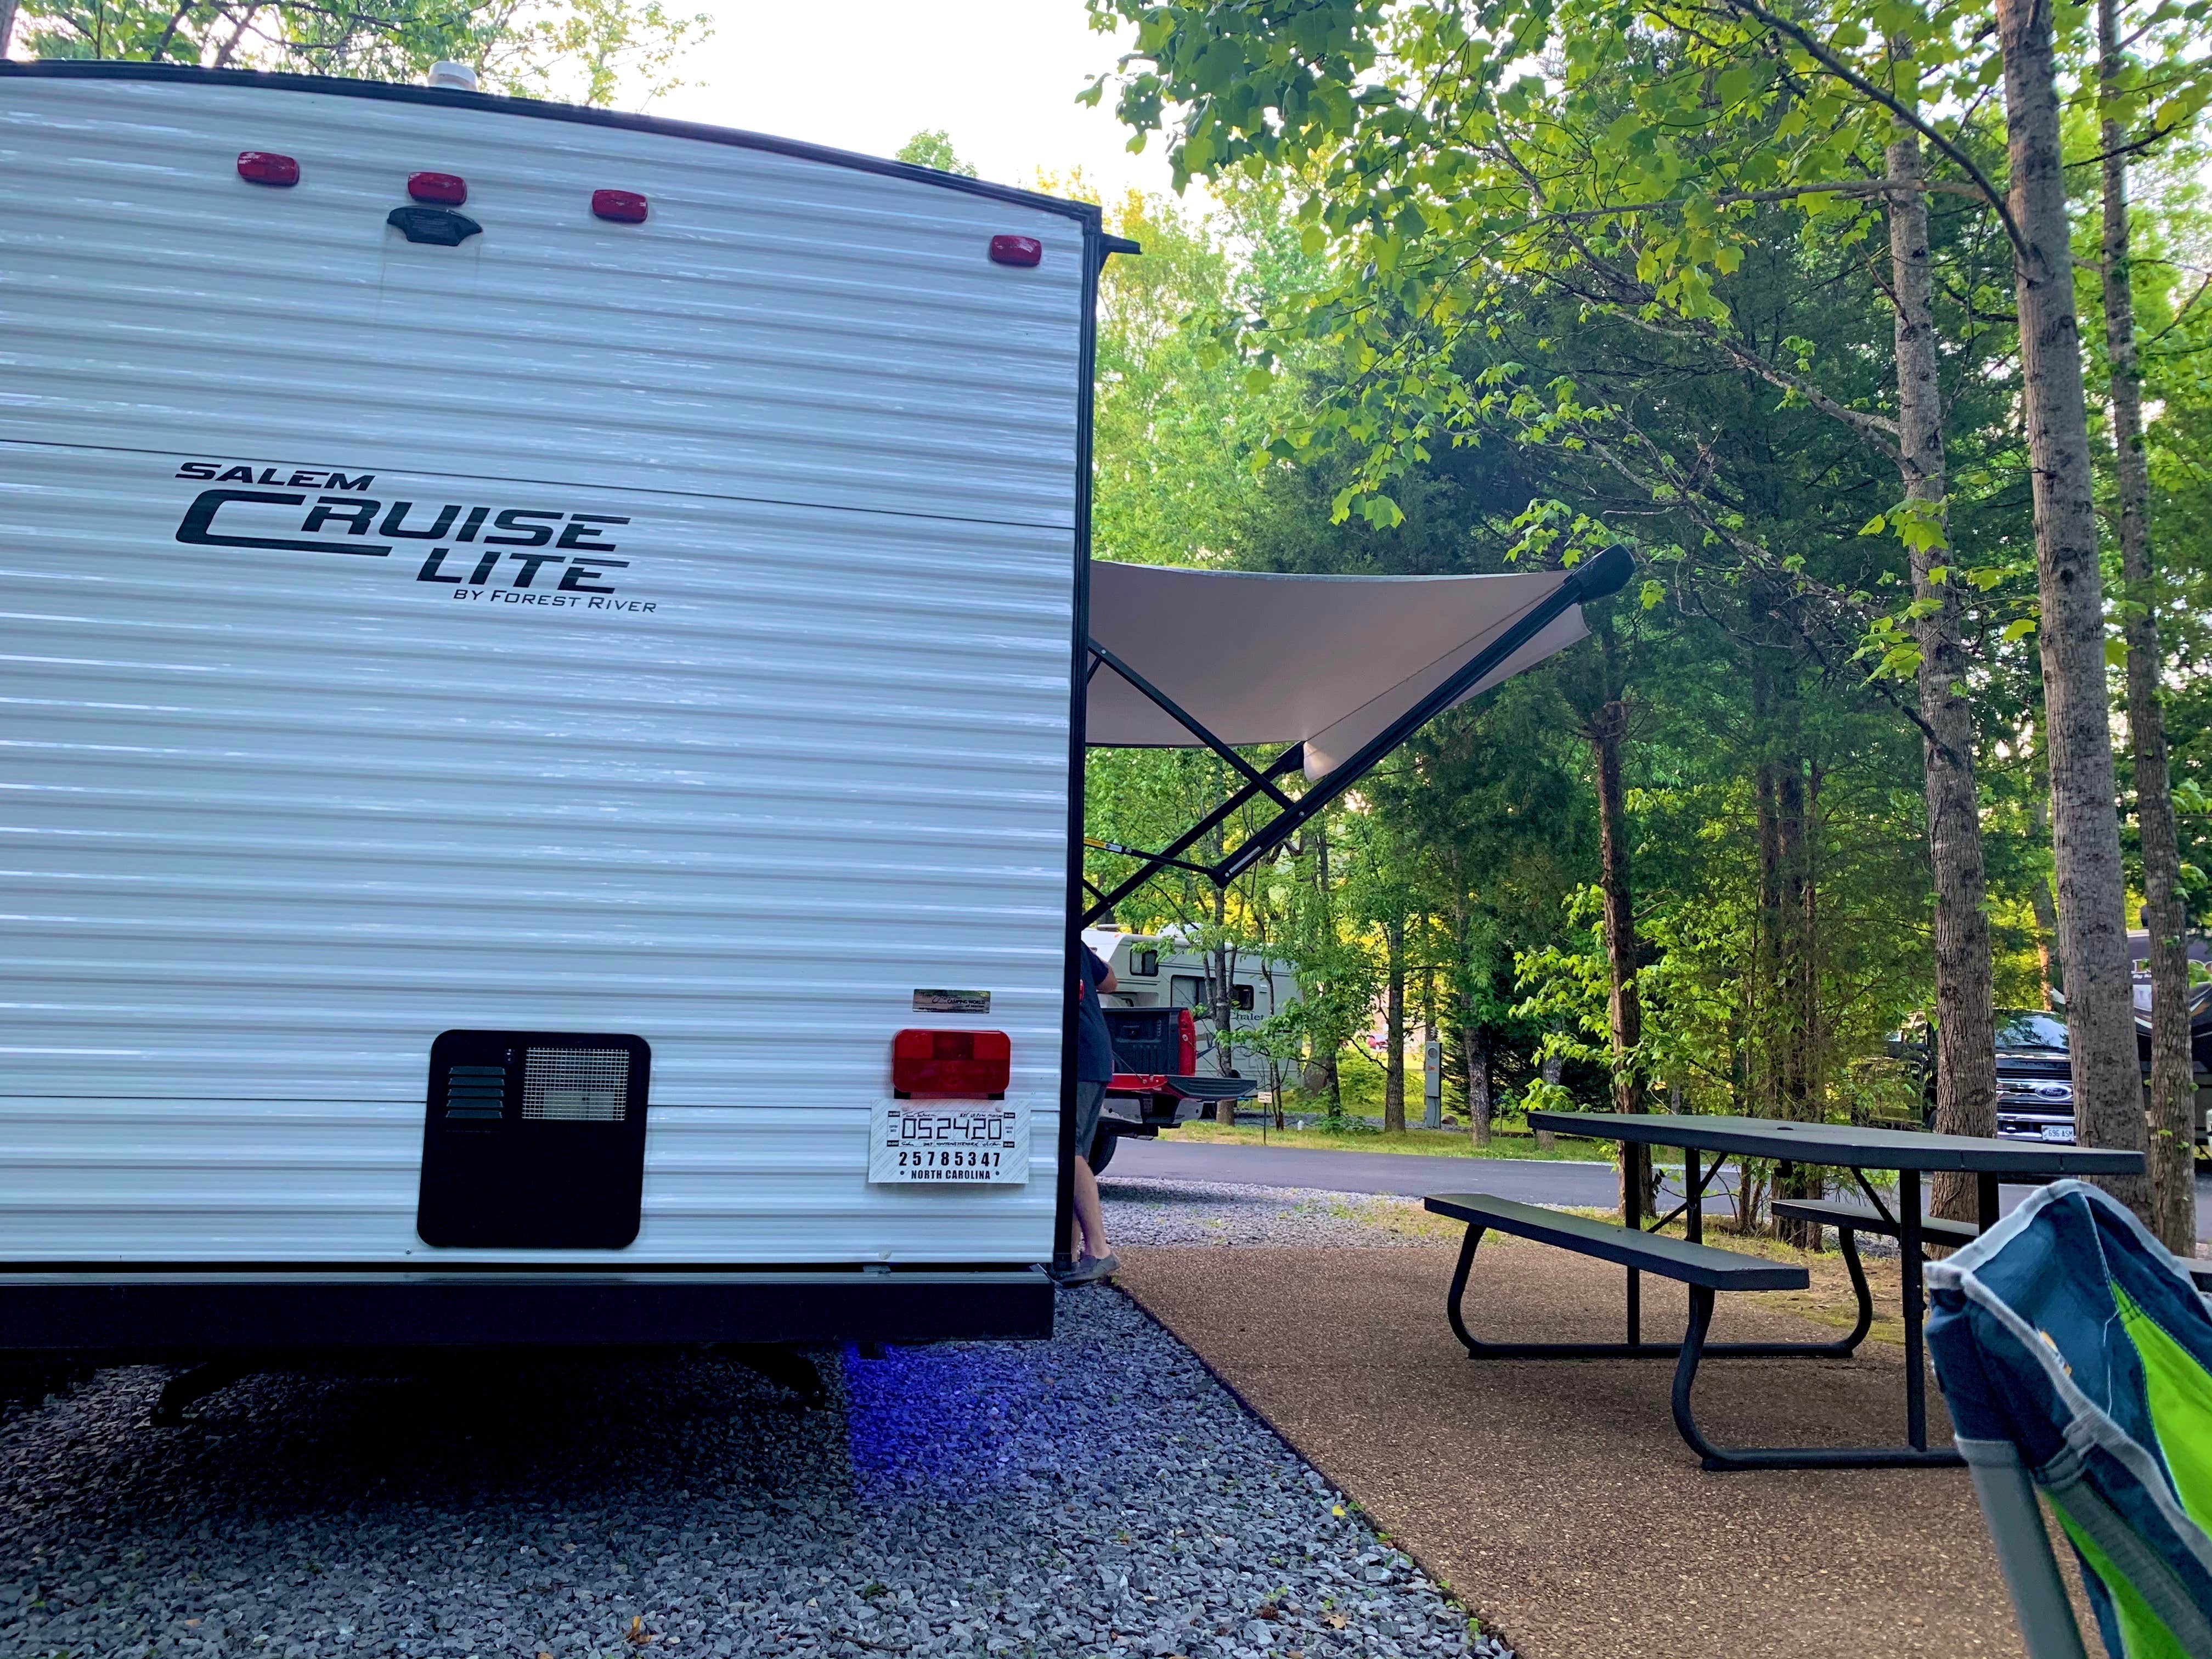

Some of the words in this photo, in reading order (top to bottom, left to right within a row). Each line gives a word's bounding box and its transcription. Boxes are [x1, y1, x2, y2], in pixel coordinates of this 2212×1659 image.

[175, 462, 375, 491] SALEM
[176, 489, 631, 556] CRUISE
[416, 548, 630, 594] LITE
[453, 589, 484, 600] BY
[901, 1118, 1002, 1140] 052420
[899, 1151, 1001, 1167] 25785347
[911, 1170, 942, 1180] NORTH
[945, 1170, 991, 1180] CAROLINA
